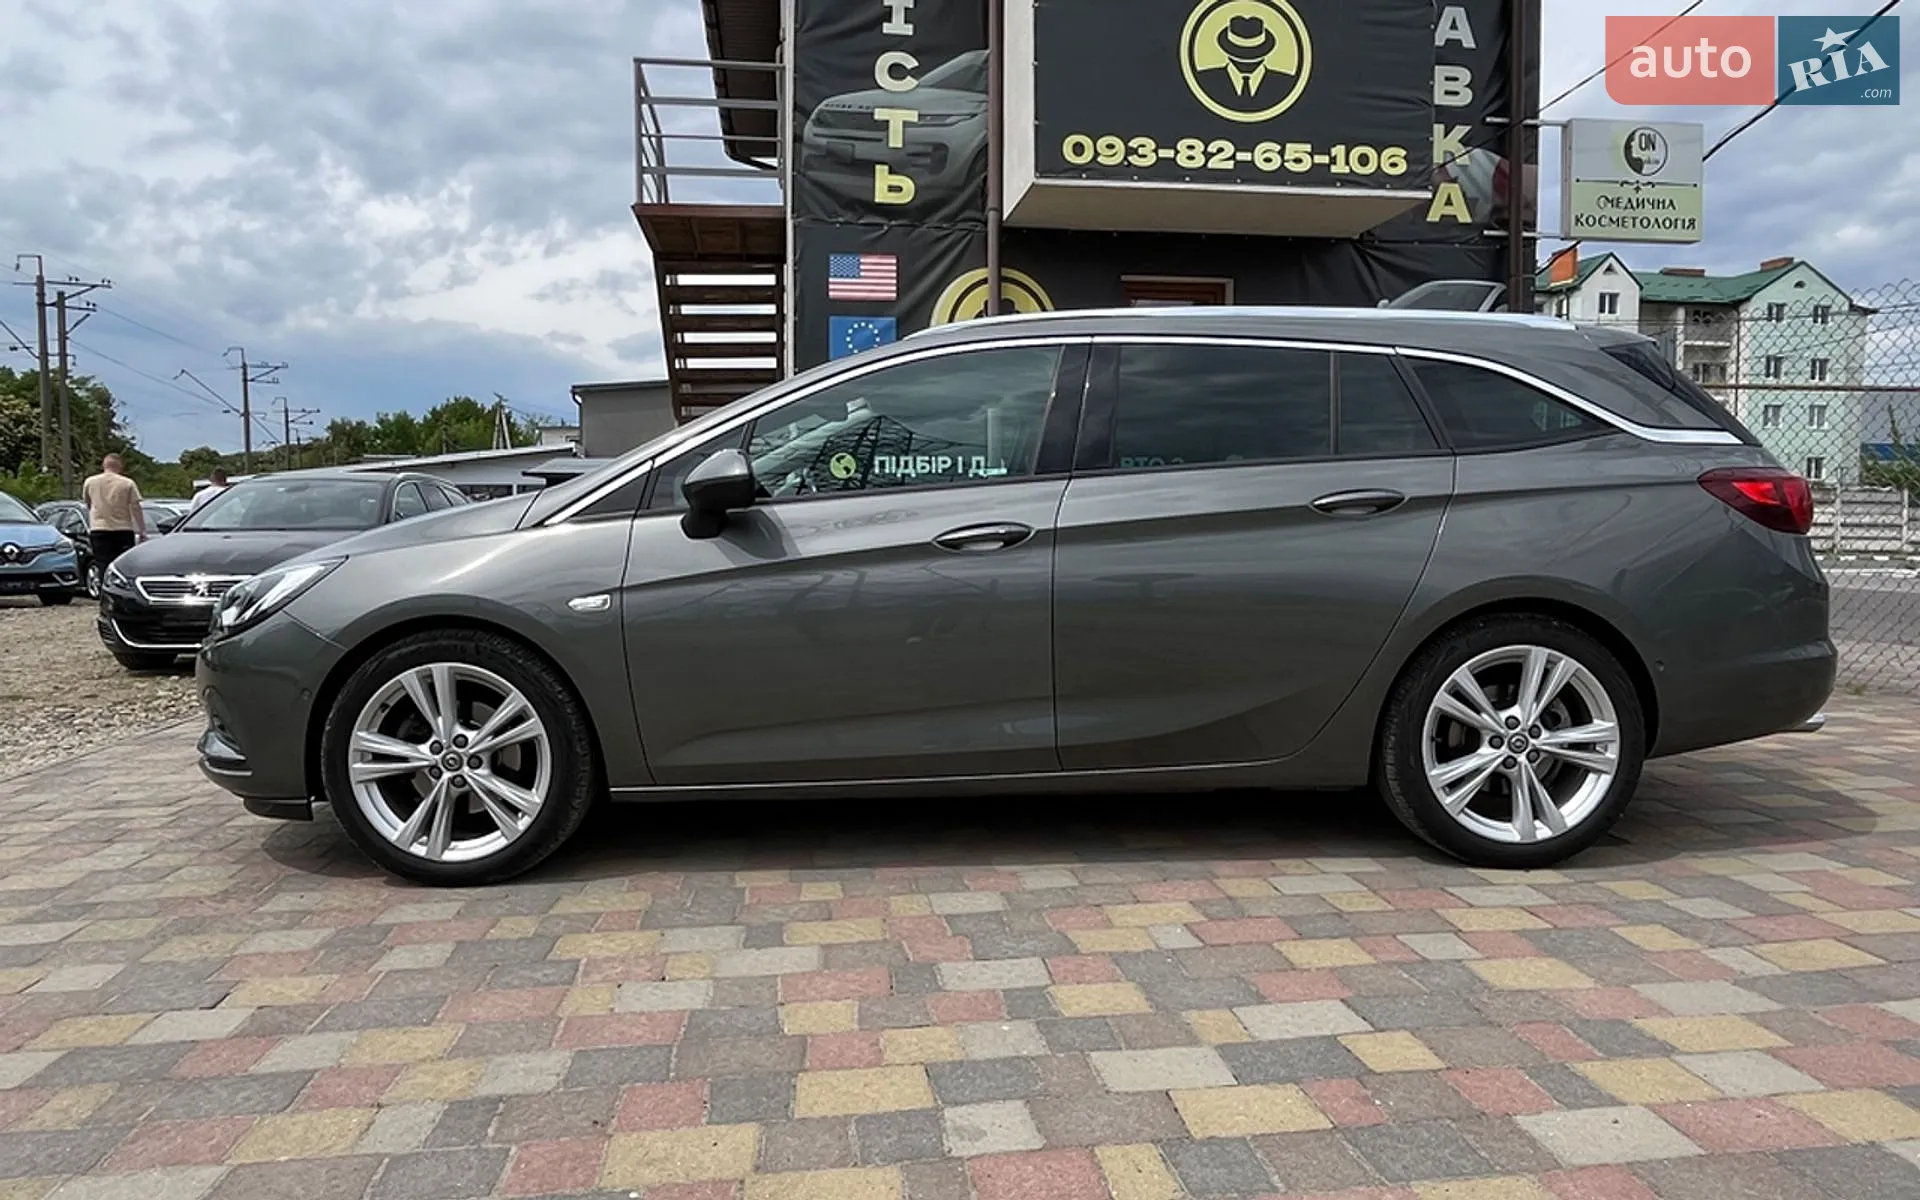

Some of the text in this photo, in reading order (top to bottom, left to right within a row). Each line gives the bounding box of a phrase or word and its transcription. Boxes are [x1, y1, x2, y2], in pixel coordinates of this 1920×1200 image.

[1062, 133, 1408, 176] 093-82-65-106
[1597, 195, 1676, 211] МЕДИЧНА
[1574, 213, 1696, 230] КОСМЕТОЛОГІЯ
[874, 455, 952, 478] ПІДБІР
